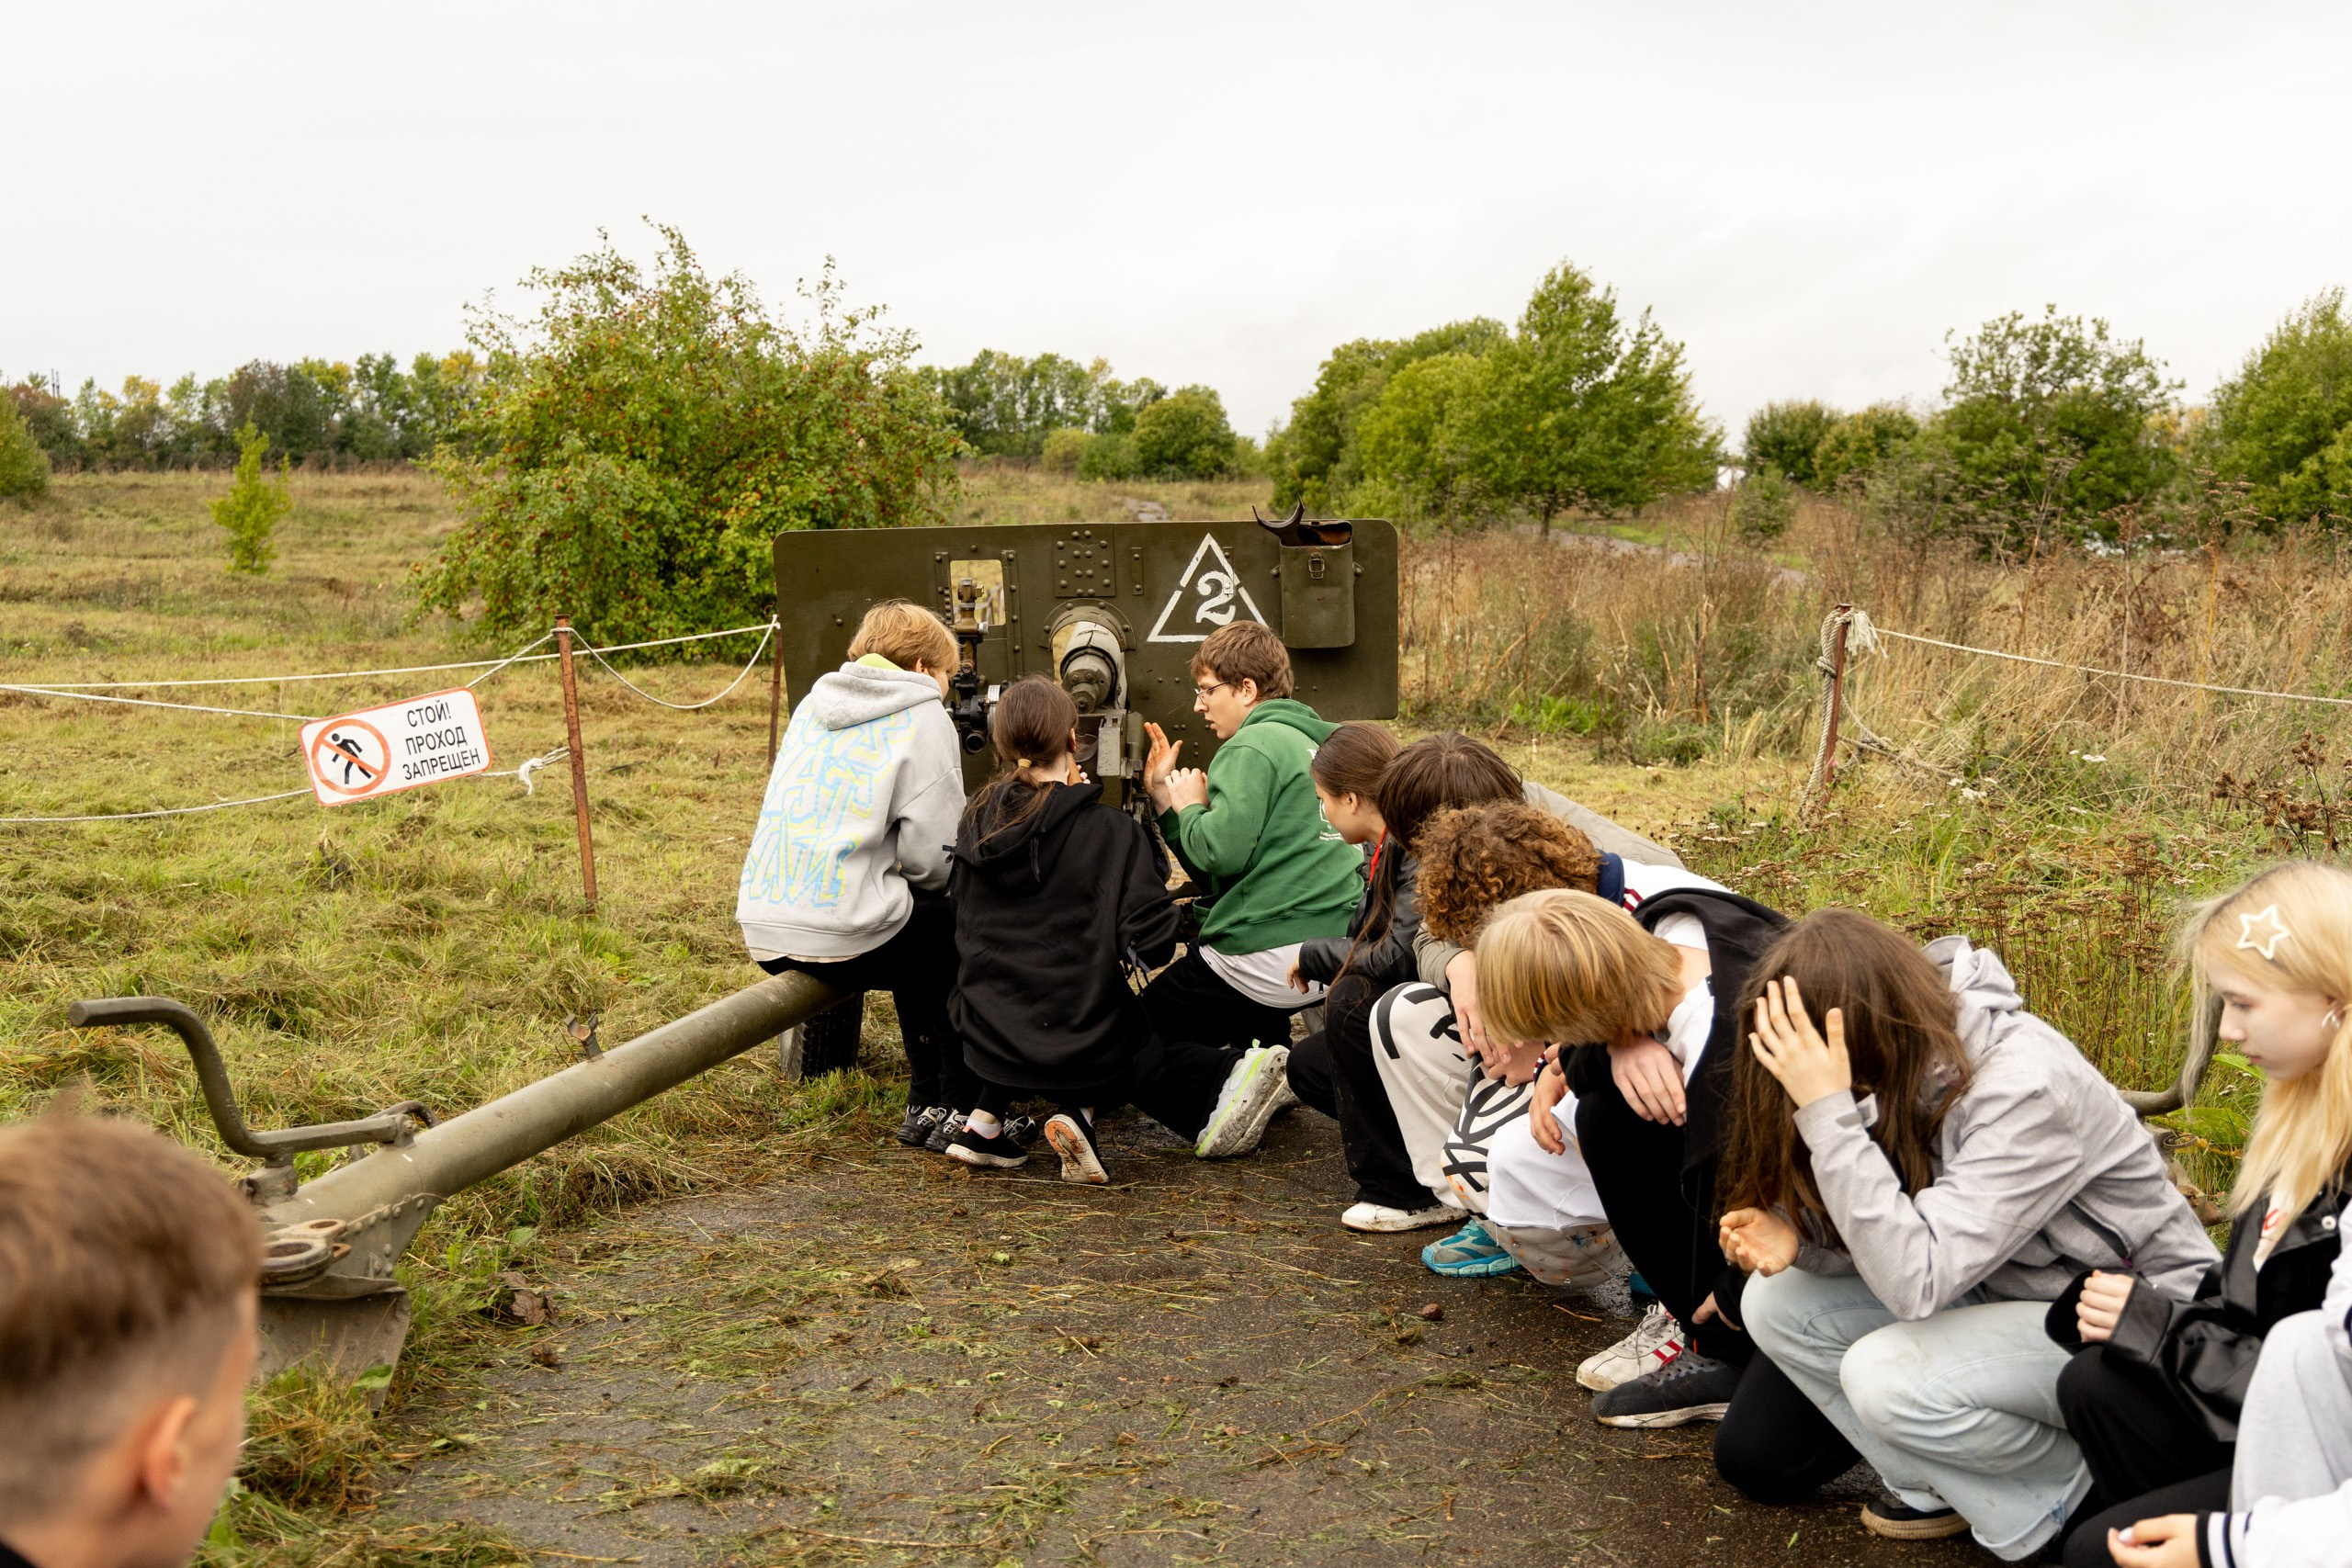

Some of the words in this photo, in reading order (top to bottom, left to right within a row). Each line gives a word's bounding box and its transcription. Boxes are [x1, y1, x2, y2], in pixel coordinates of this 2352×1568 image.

[1196, 570, 1237, 626] 2
[407, 699, 451, 728] СТОЙ!
[405, 726, 468, 755] ПРОХОД
[402, 748, 481, 780] ЗАПРЕЩЕН
